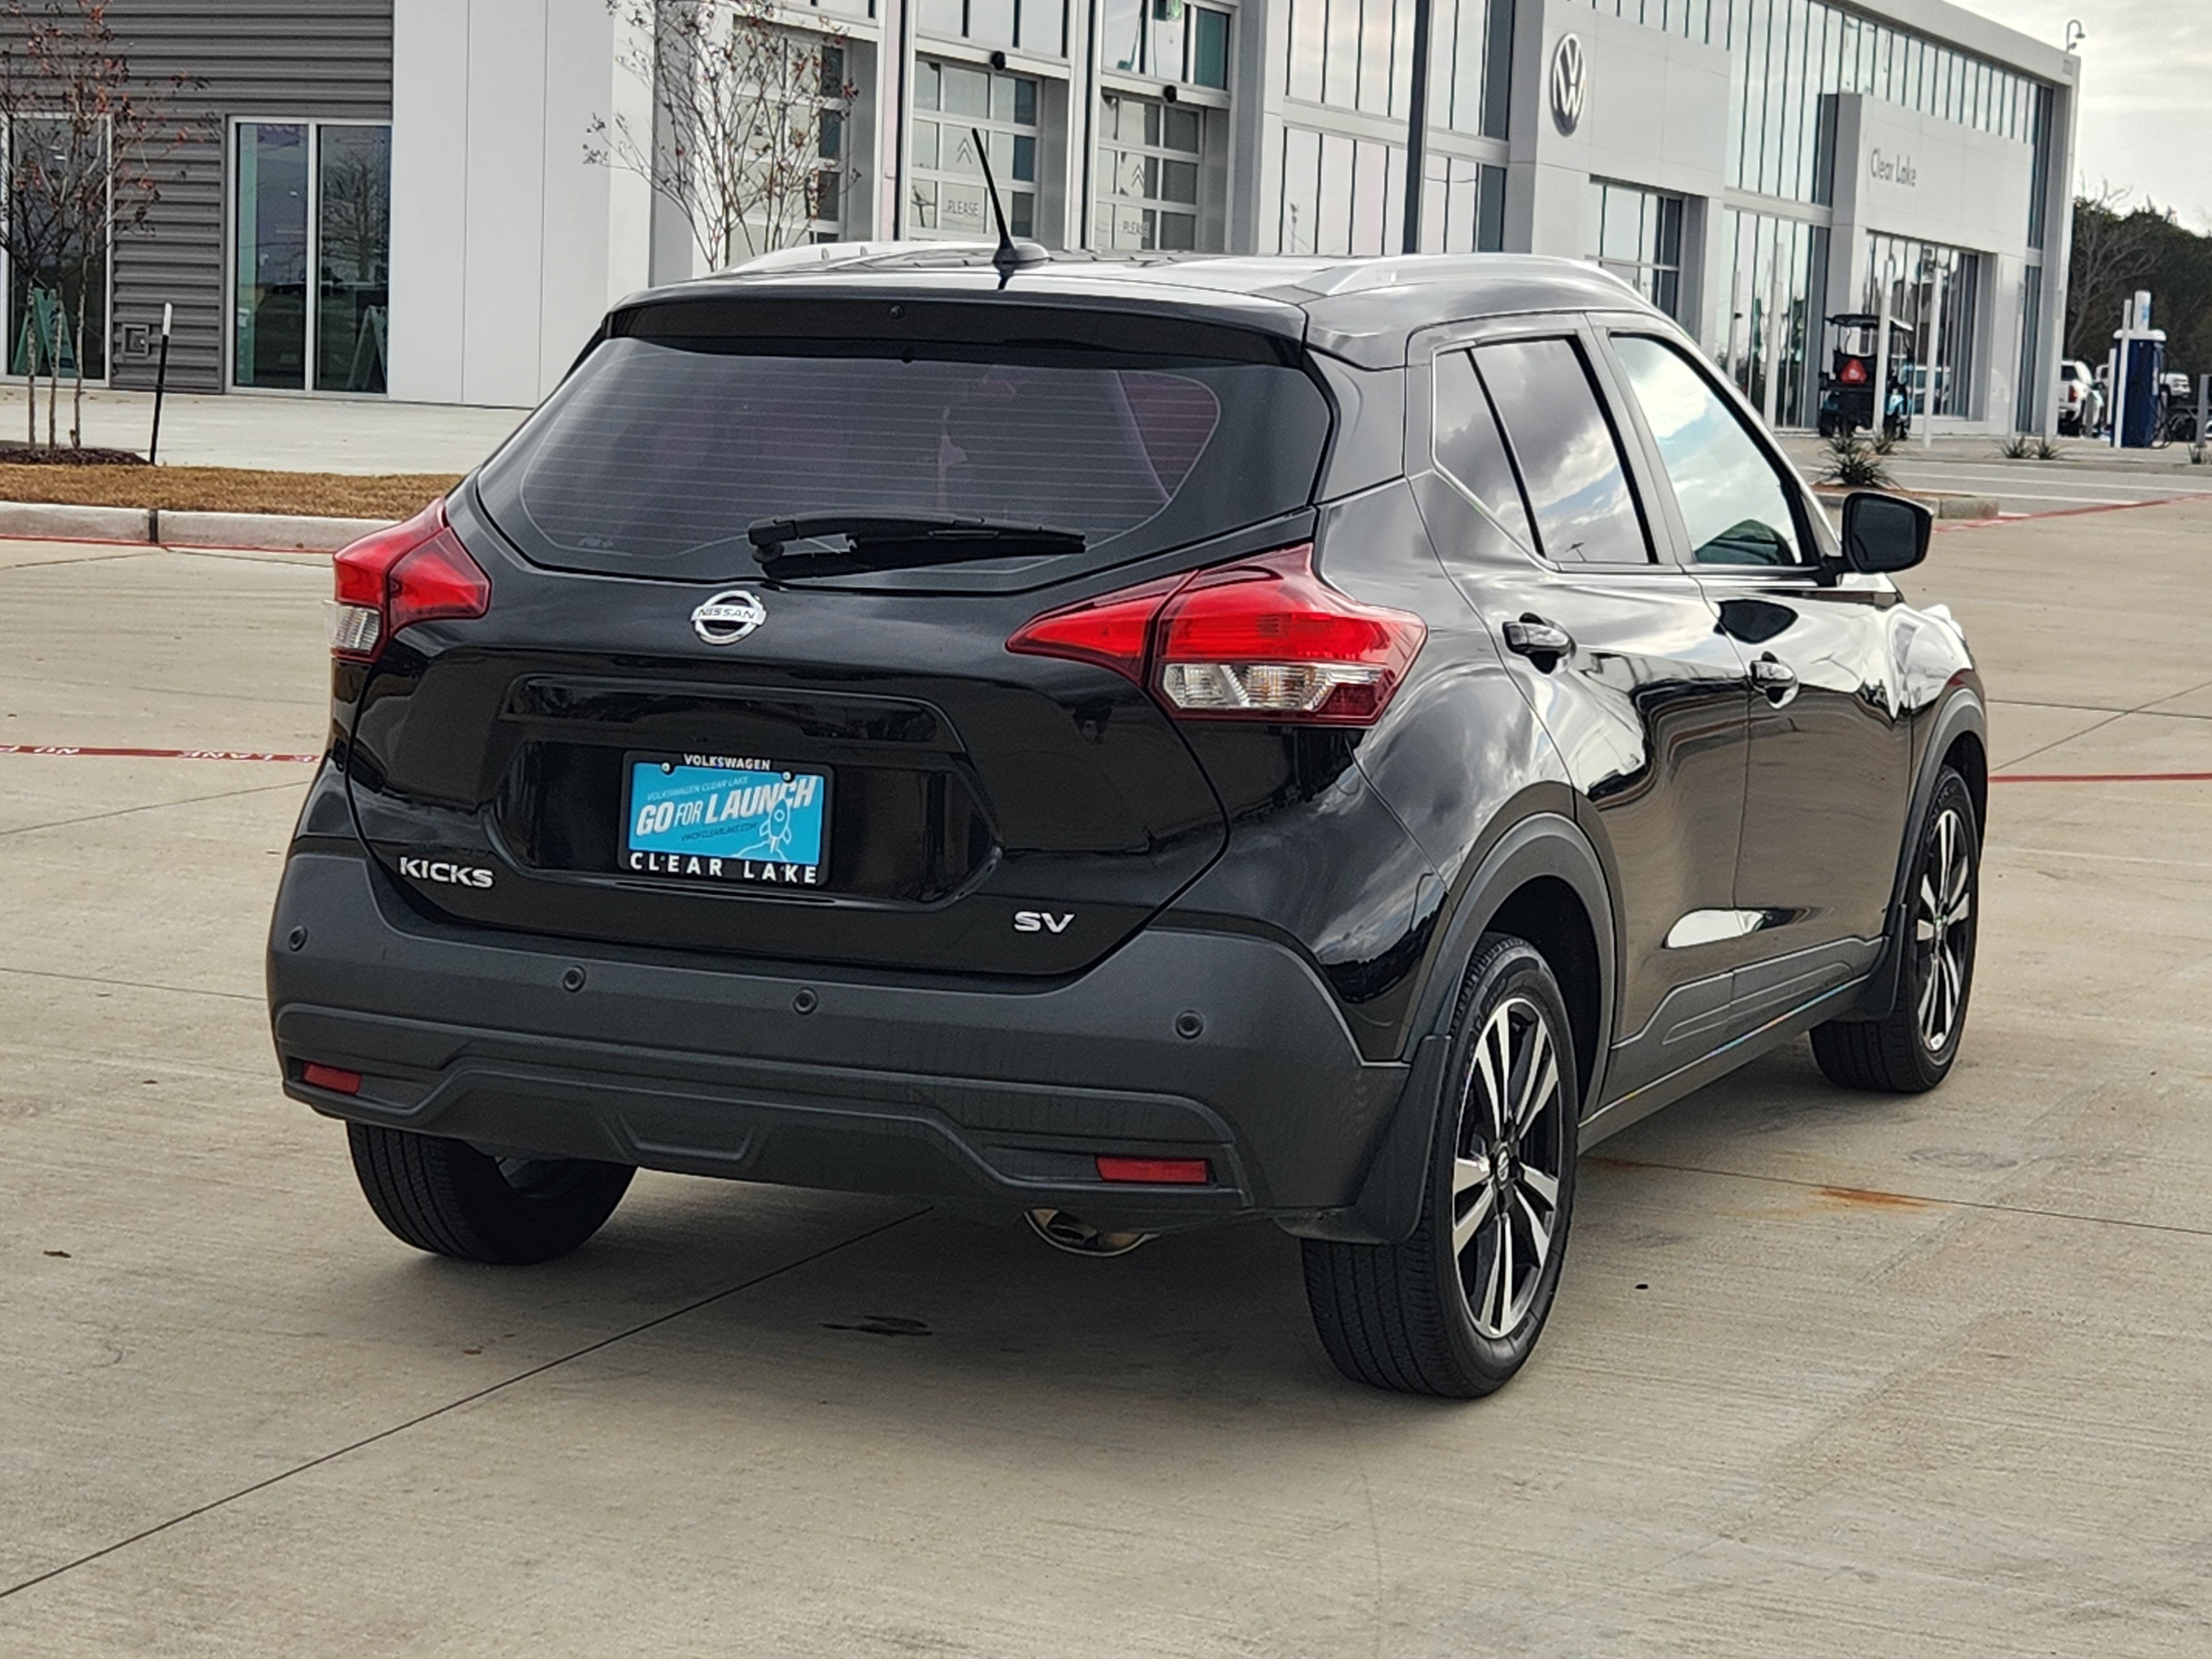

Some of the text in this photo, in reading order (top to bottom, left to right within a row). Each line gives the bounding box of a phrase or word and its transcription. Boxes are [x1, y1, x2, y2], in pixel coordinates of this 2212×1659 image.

[1871, 148, 1916, 187] Clear Lake
[948, 200, 979, 216] PLEASE
[698, 608, 756, 619] NISSAN
[683, 753, 771, 771] VOLKSWAGEN
[636, 776, 817, 837] GO FOR LAUNCH
[400, 857, 493, 888] KICKS
[630, 852, 816, 884] CLEAR LAKE
[1014, 911, 1076, 933] SV
